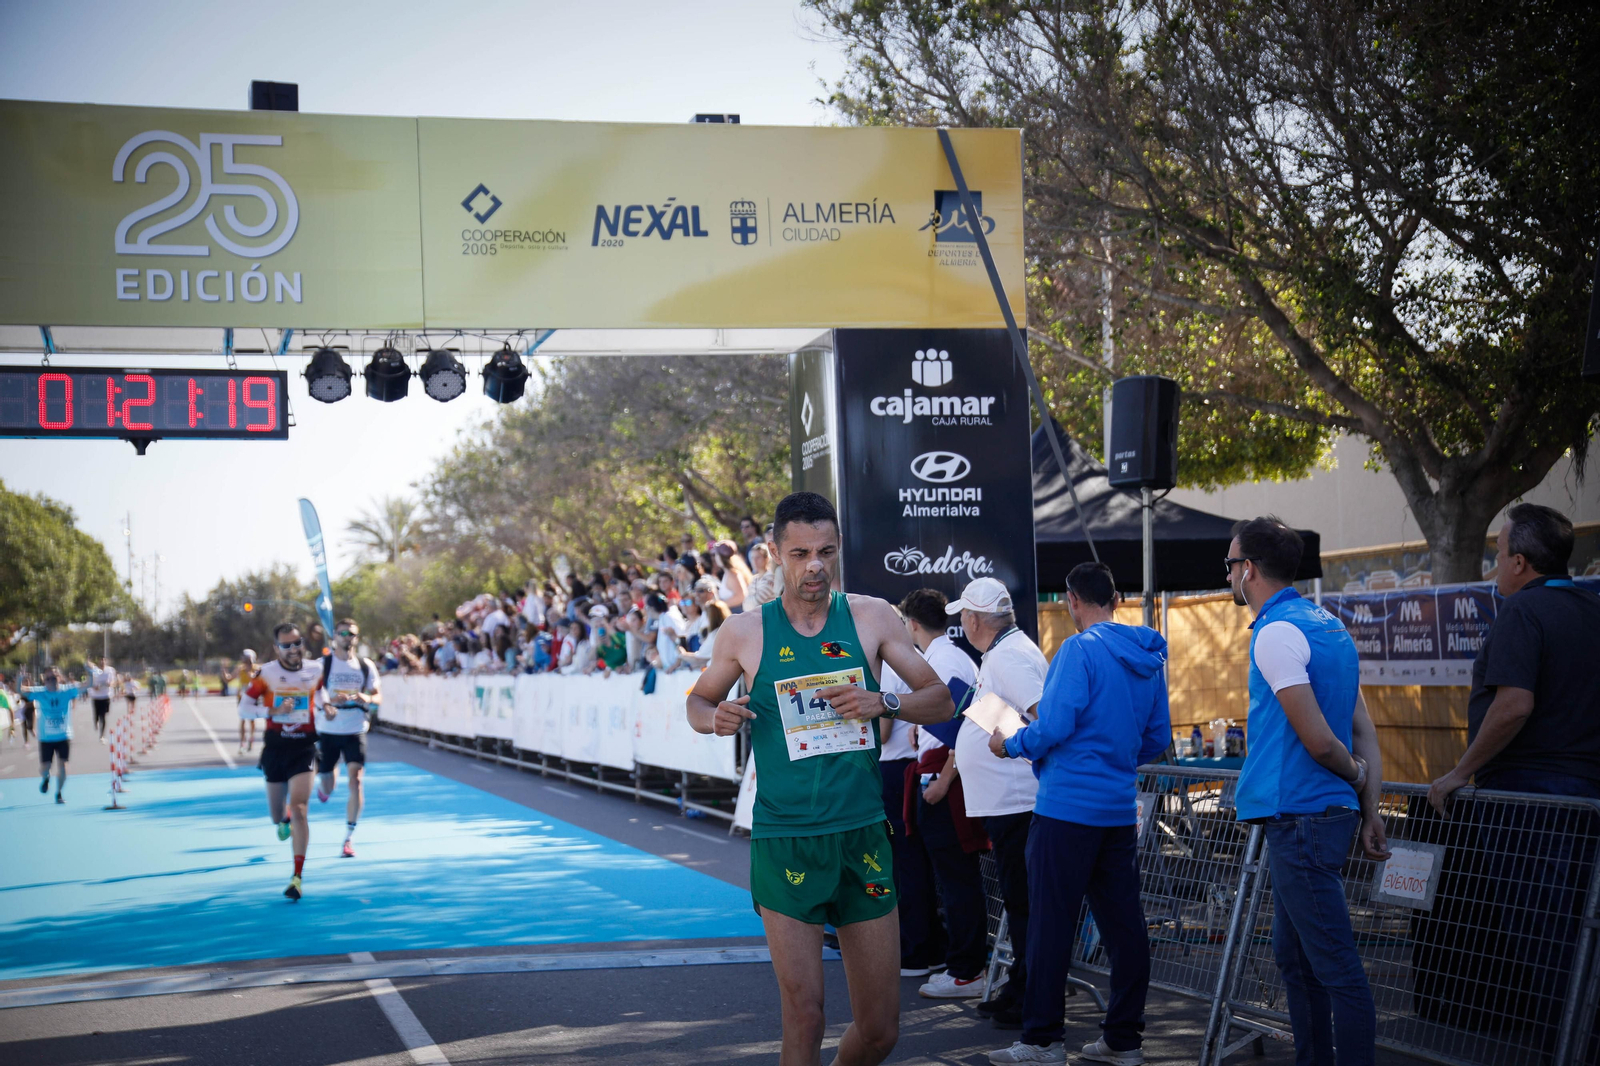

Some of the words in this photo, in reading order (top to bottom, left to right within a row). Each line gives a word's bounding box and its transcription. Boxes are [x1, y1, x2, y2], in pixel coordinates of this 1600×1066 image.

[112, 130, 299, 258] 25
[782, 197, 896, 224] ALMERÍA
[591, 197, 709, 247] NEXAL
[461, 228, 566, 244] COOPERACIÓN
[601, 239, 624, 247] 2020
[782, 228, 841, 242] CIUDAD
[461, 242, 498, 256] 2005
[115, 263, 303, 303] EDICIÓN
[870, 388, 995, 425] cajamar
[931, 417, 957, 426] CAJA
[959, 417, 993, 426] RURAL
[898, 488, 981, 502] HYUNDAI
[902, 504, 980, 518] Almerialva
[1409, 623, 1432, 633] Maratón
[1393, 632, 1433, 653] Almería
[1447, 631, 1485, 652] Almerí
[805, 713, 826, 722] PAEZ
[1384, 873, 1426, 893] EVENTOS
